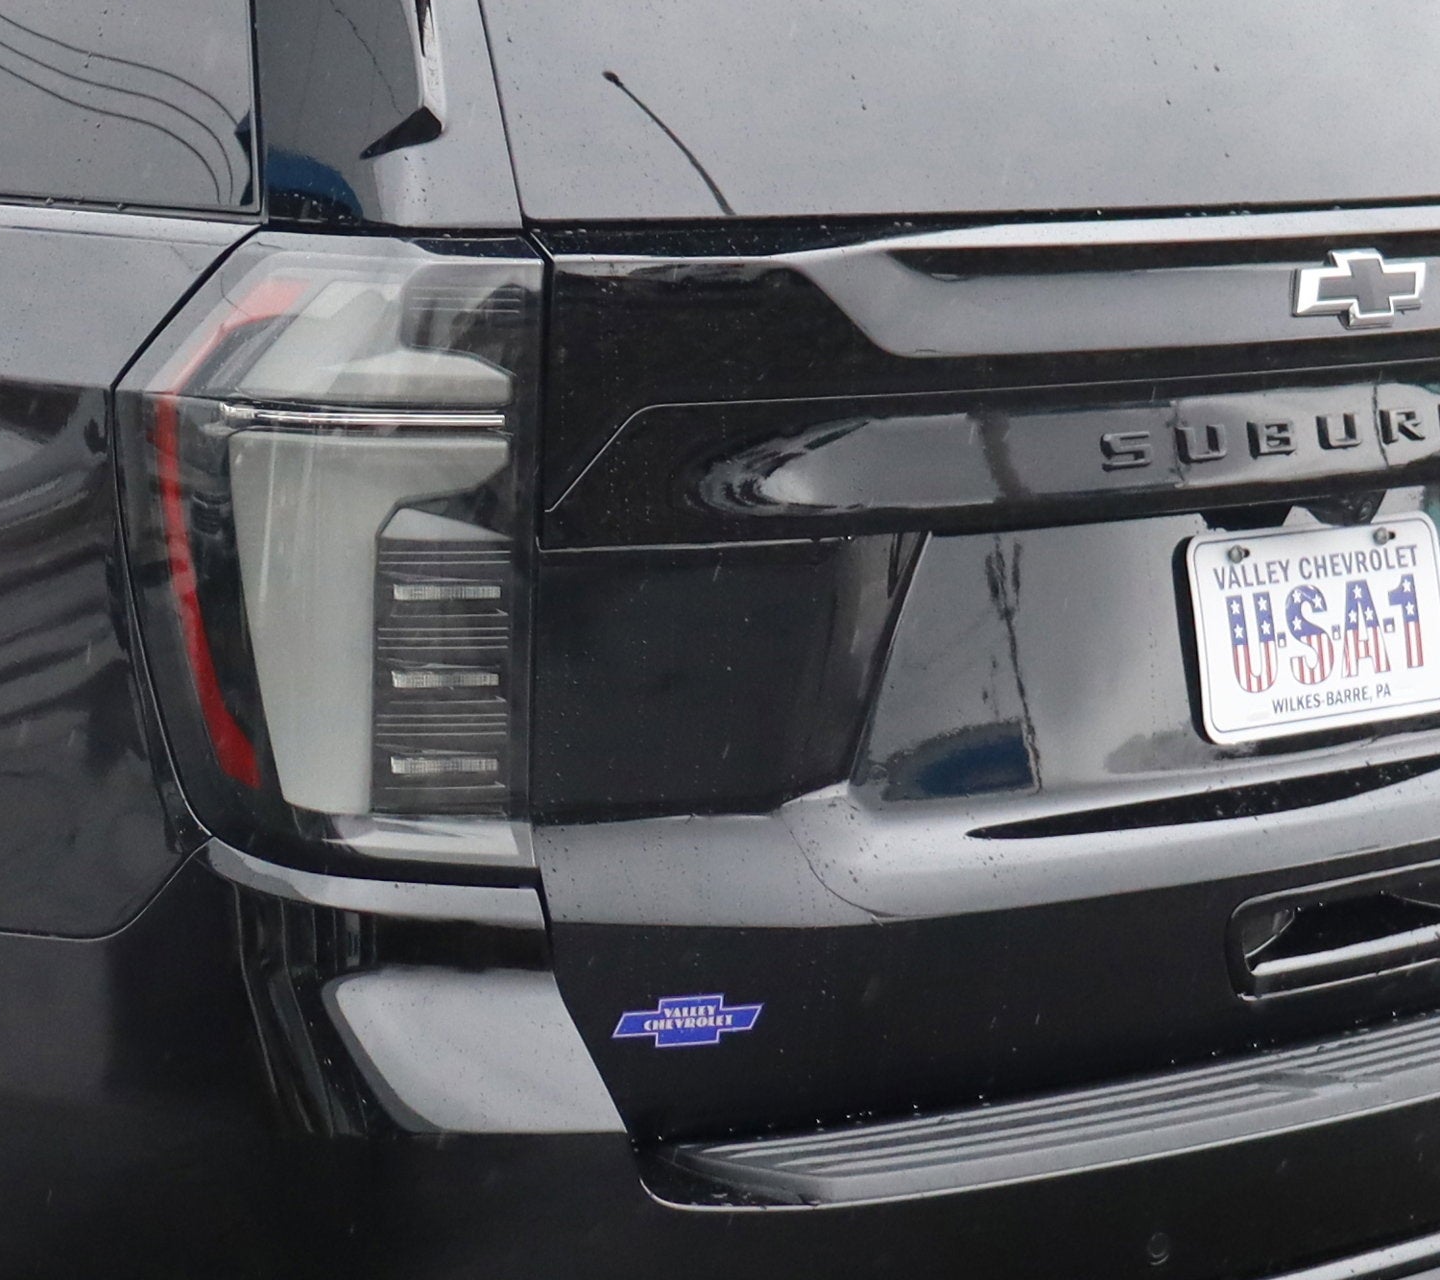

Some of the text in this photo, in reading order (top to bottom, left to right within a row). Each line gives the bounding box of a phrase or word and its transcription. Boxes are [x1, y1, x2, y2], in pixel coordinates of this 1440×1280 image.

[1213, 544, 1418, 591] VALLEY CHEVROLET
[1272, 683, 1392, 715] WILKES-BARRE, PA
[643, 1004, 733, 1031] VALLEY CHEVROLET
